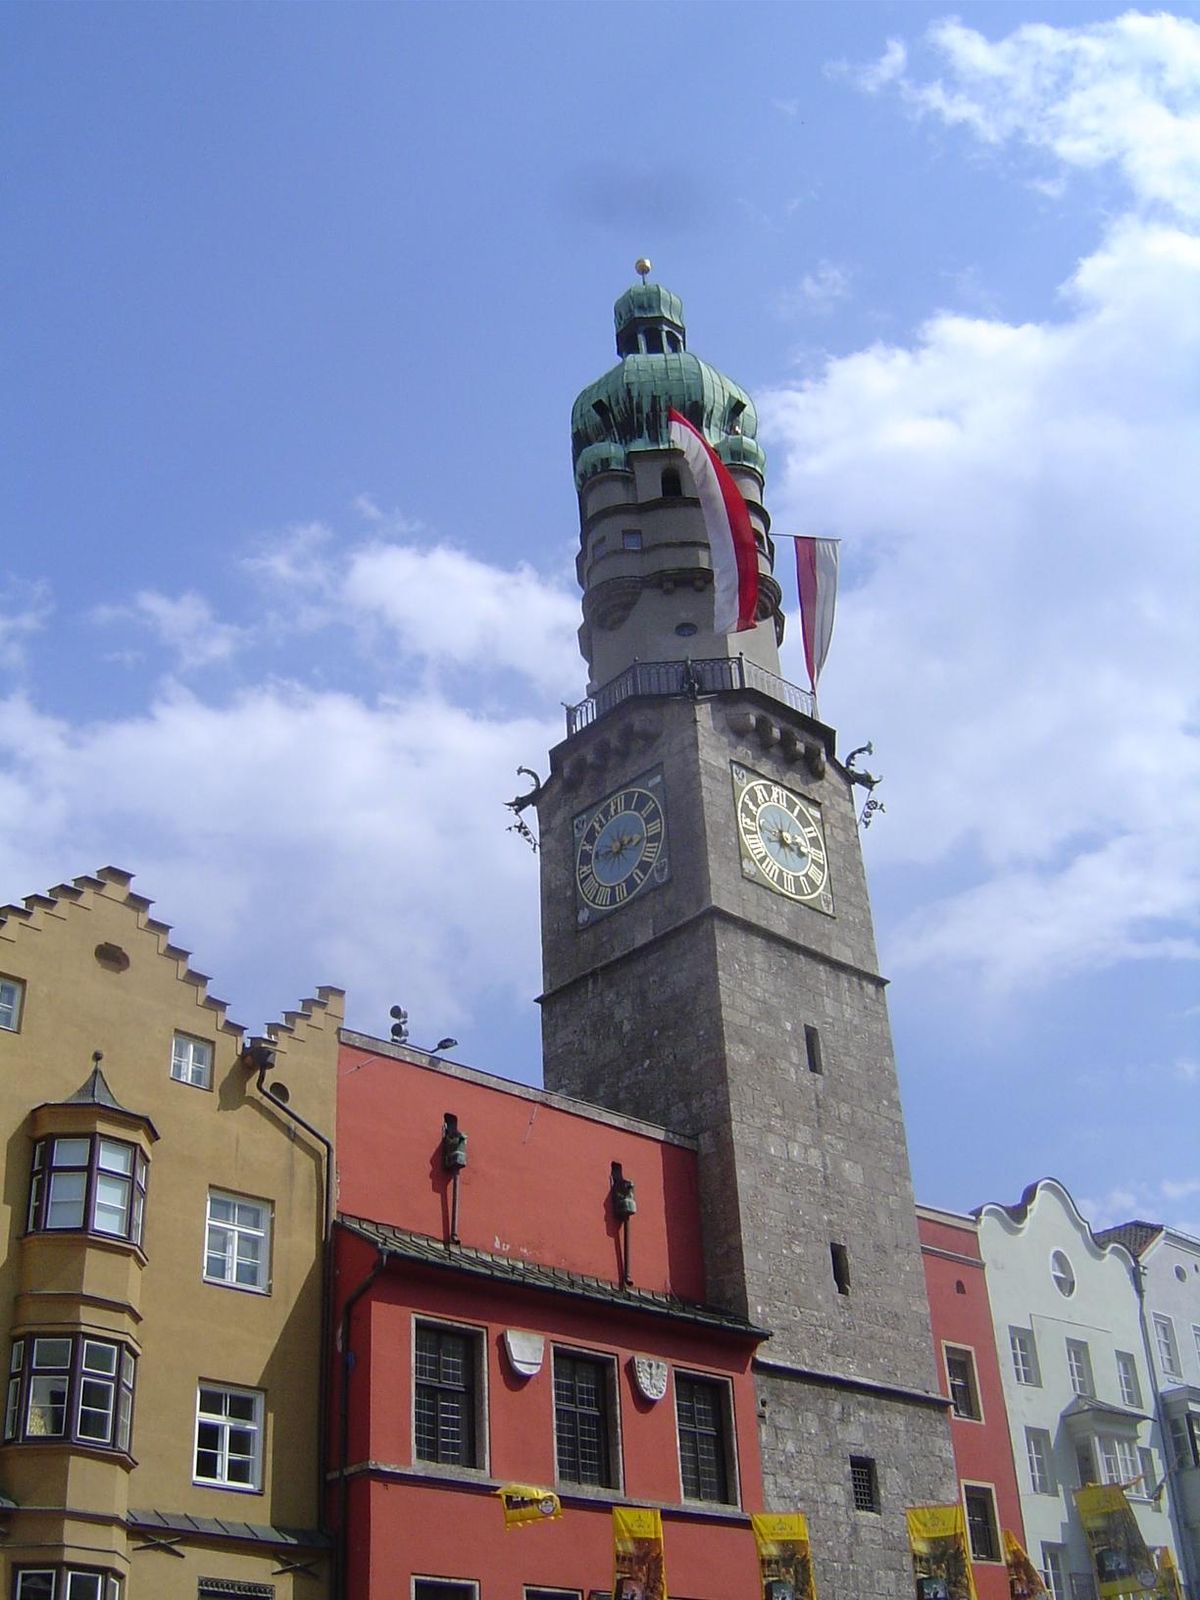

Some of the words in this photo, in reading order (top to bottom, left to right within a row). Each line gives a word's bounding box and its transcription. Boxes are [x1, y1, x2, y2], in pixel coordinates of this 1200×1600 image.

[642, 800, 655, 817] II
[647, 819, 661, 836] III
[805, 826, 817, 838] II
[582, 841, 593, 853] X
